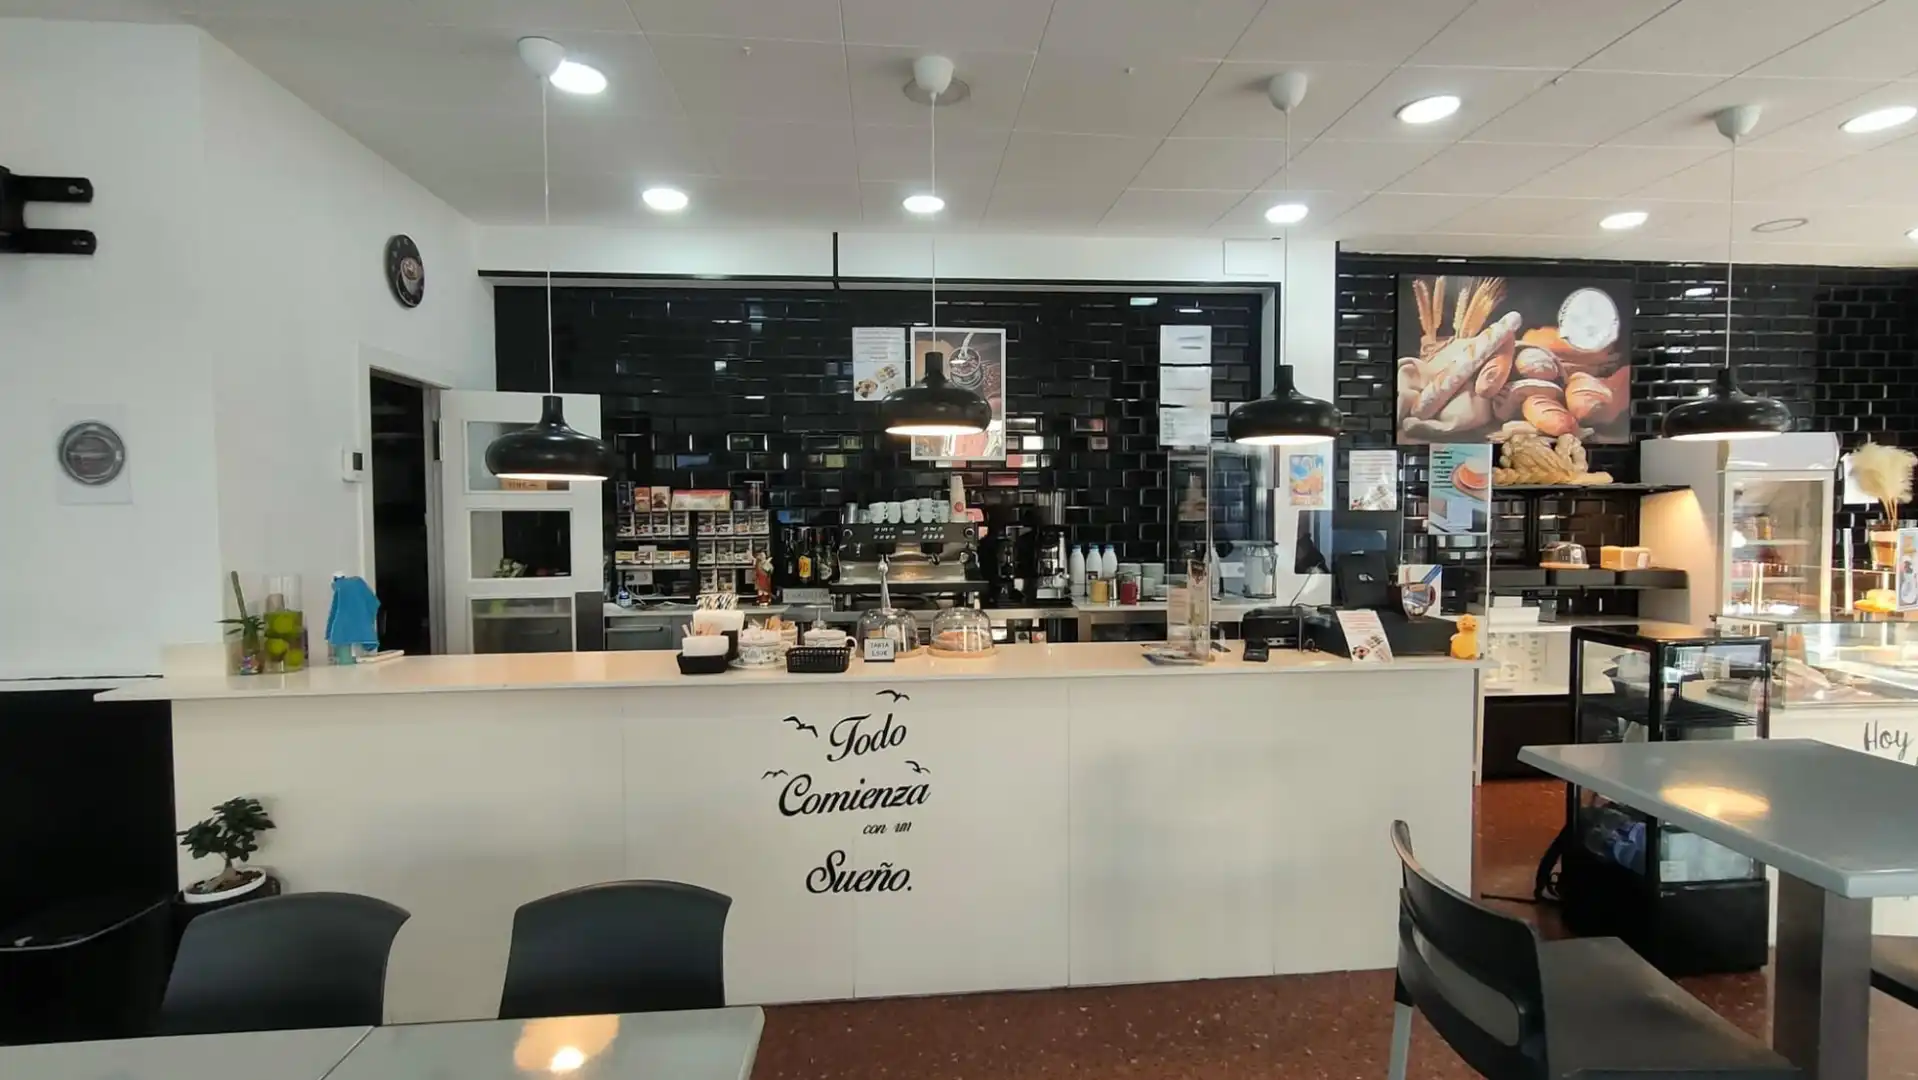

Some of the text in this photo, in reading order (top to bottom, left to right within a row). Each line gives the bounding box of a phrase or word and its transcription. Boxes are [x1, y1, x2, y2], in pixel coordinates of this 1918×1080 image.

[869, 641, 890, 649] TARTA
[826, 713, 907, 762] Todo
[1863, 720, 1915, 761] Hoy
[778, 774, 931, 816] Comienza
[862, 821, 912, 835] con un
[805, 849, 912, 894] Sueño.
